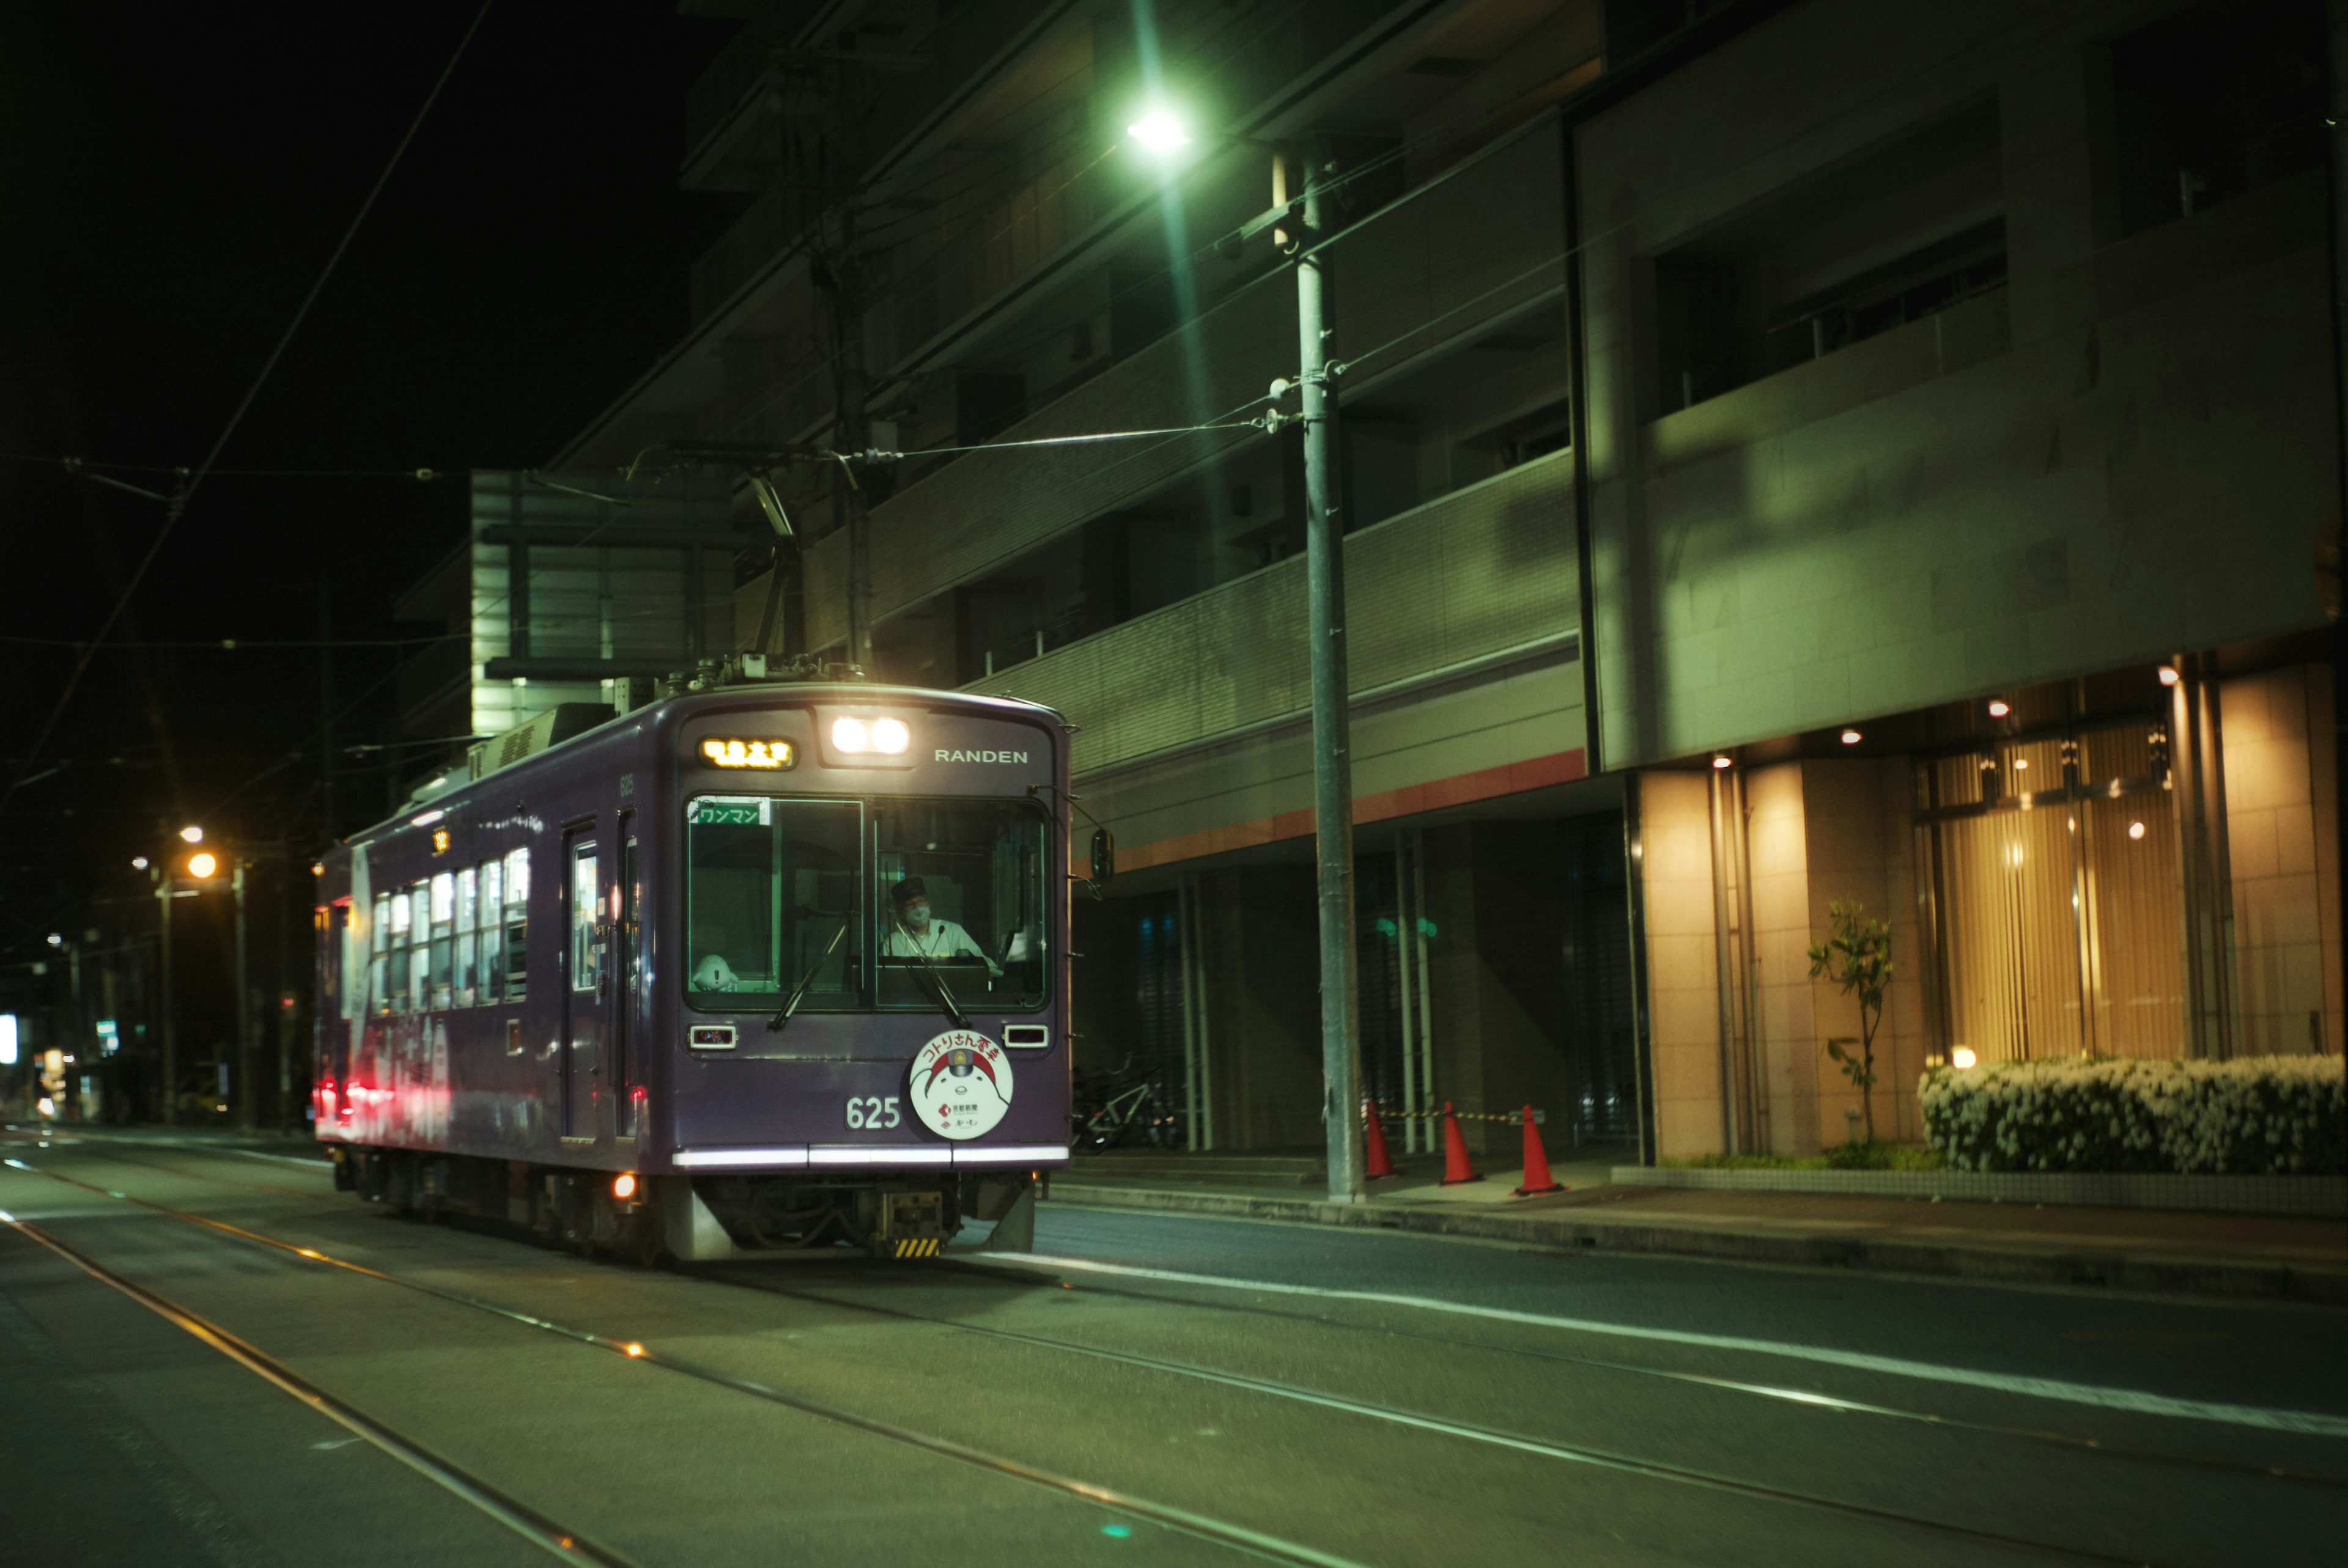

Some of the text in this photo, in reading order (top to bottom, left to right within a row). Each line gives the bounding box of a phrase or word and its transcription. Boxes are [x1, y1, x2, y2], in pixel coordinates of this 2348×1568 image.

[934, 749, 1028, 764] RANDEN
[700, 809, 758, 823] ワンマン
[846, 1096, 900, 1129] 625
